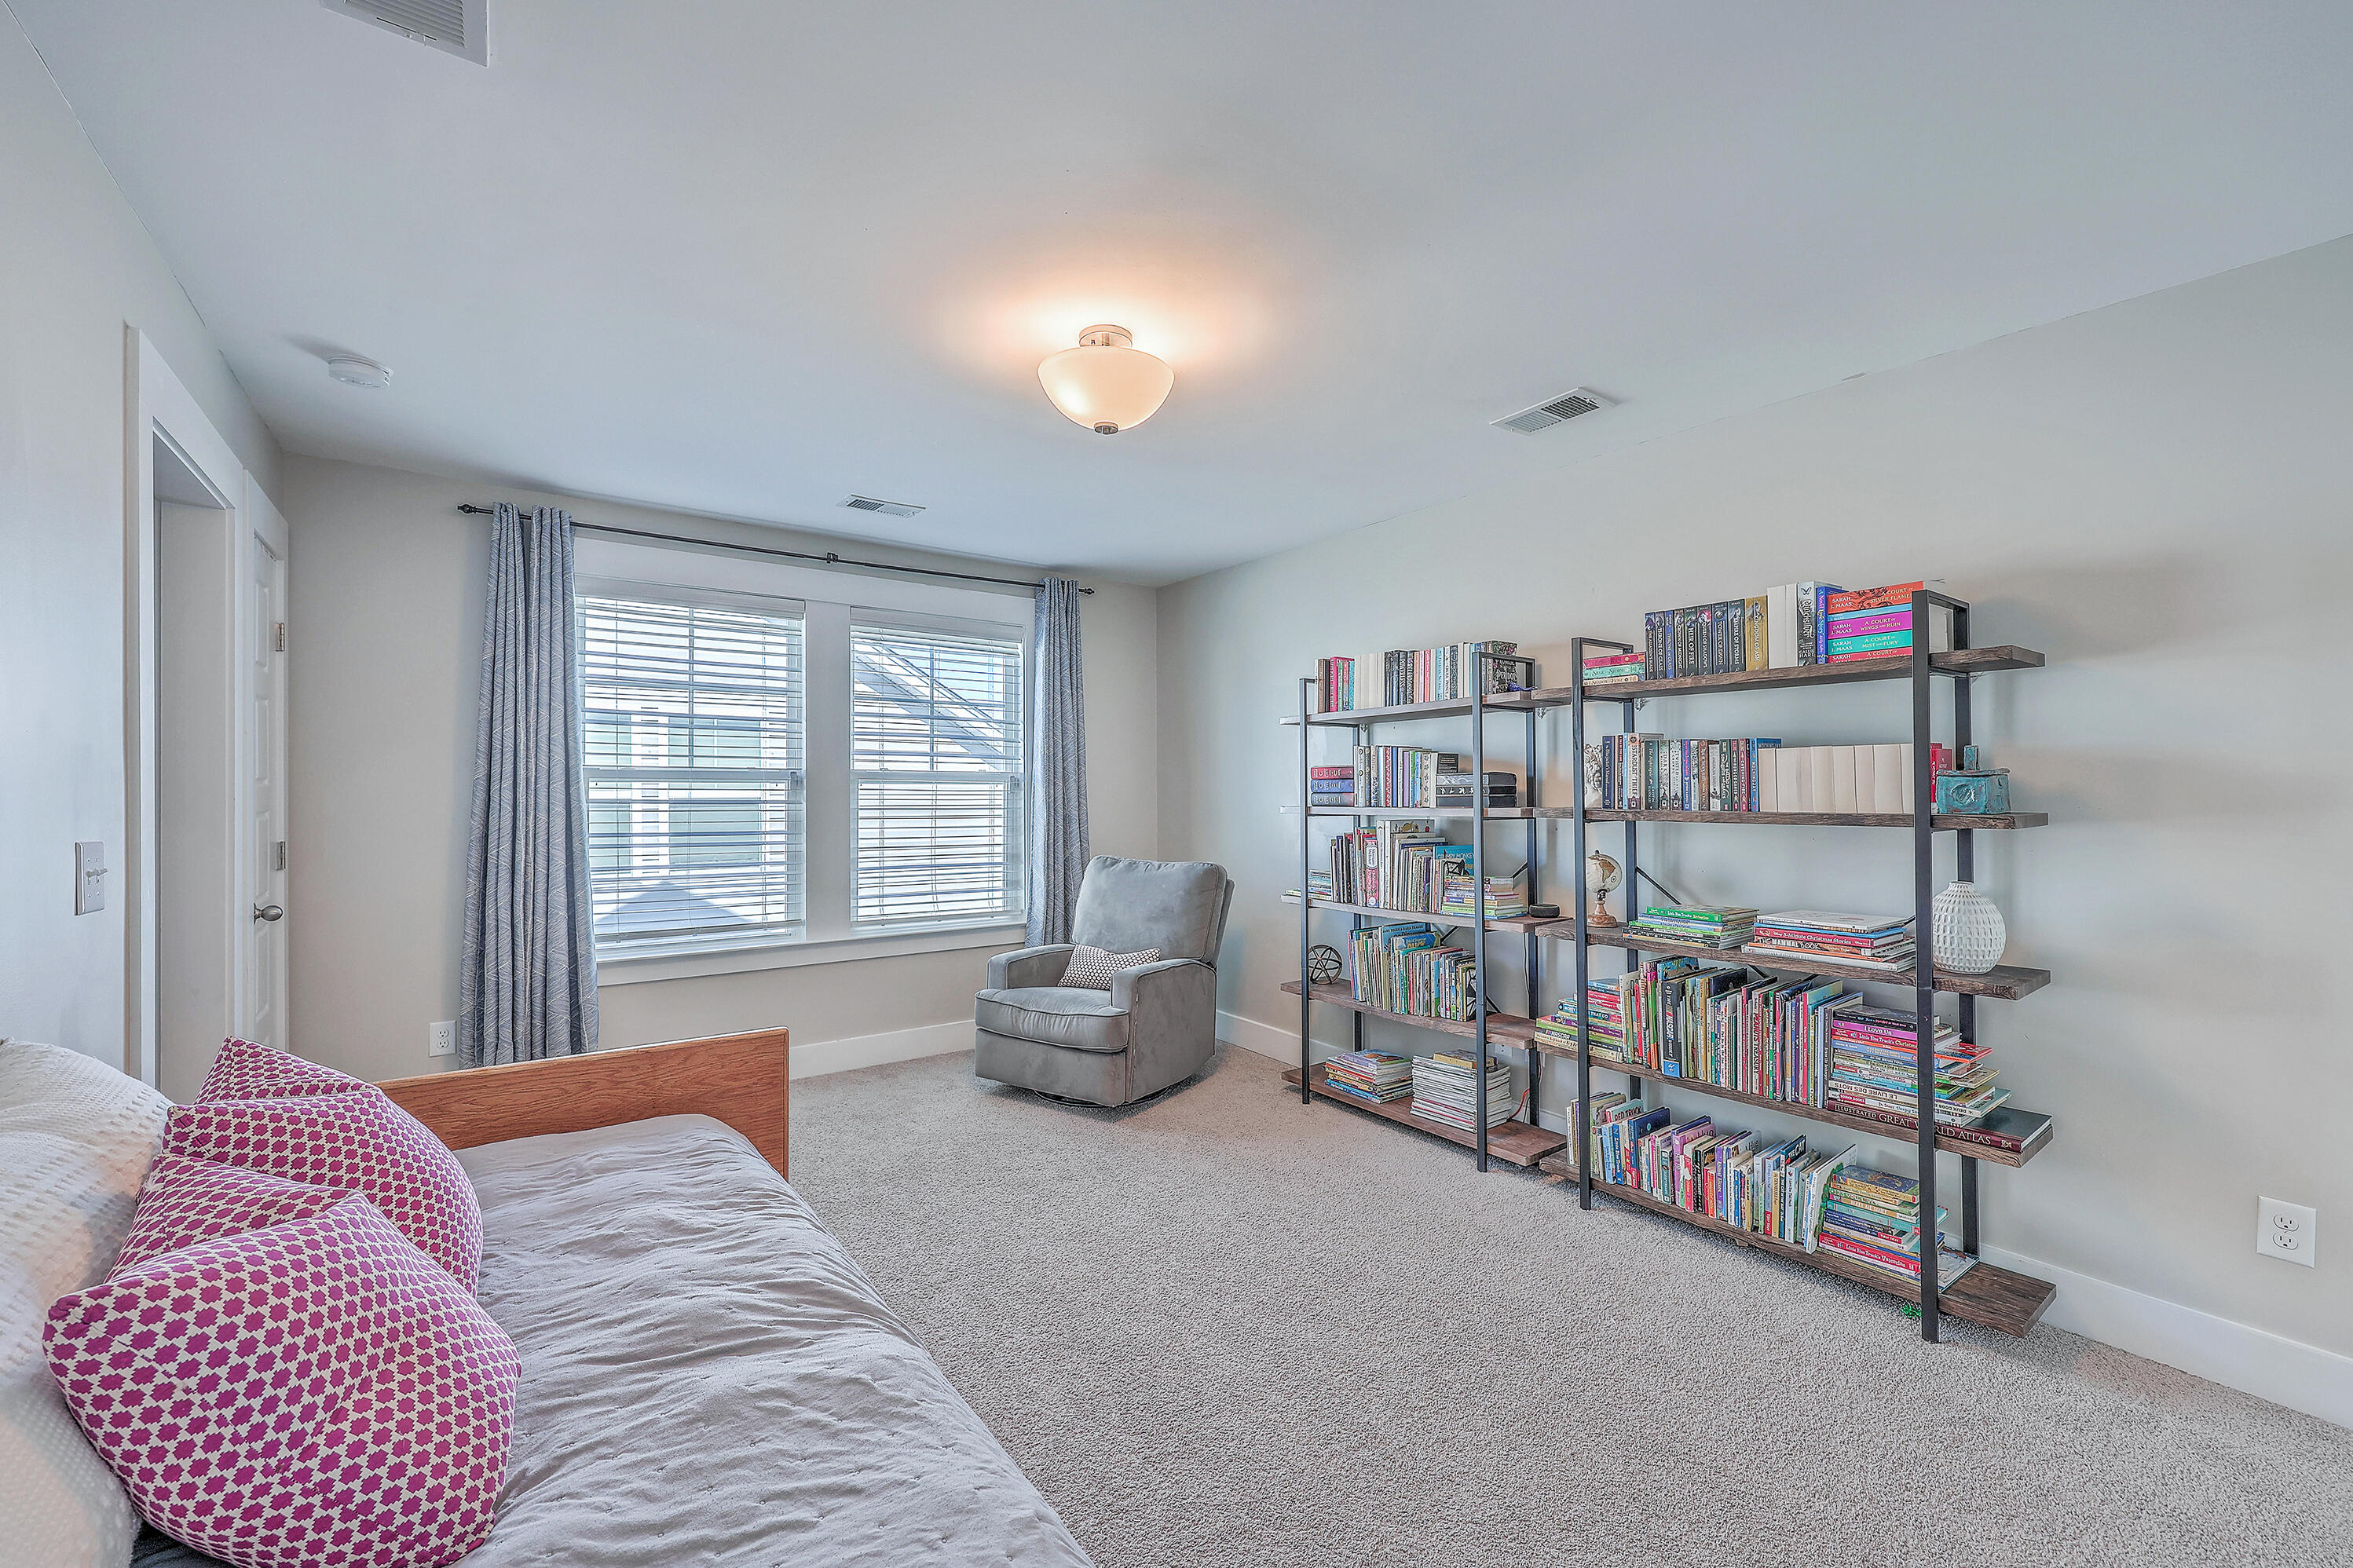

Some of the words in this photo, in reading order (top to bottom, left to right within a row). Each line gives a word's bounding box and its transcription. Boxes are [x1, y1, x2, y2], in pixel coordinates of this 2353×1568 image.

[1799, 599, 1814, 638] Quicksilver
[1688, 642, 1695, 651] OF
[1665, 1016, 1674, 1038] NASCAR
[1552, 1029, 1571, 1040] NASCAR
[1868, 1088, 1887, 1098] LIVRE
[1835, 1105, 1877, 1118] ILLUSTRATED
[1879, 1113, 1912, 1128] GREAT
[1958, 1129, 1992, 1145] ATLAS
[1882, 1255, 1905, 1267] Valentine
